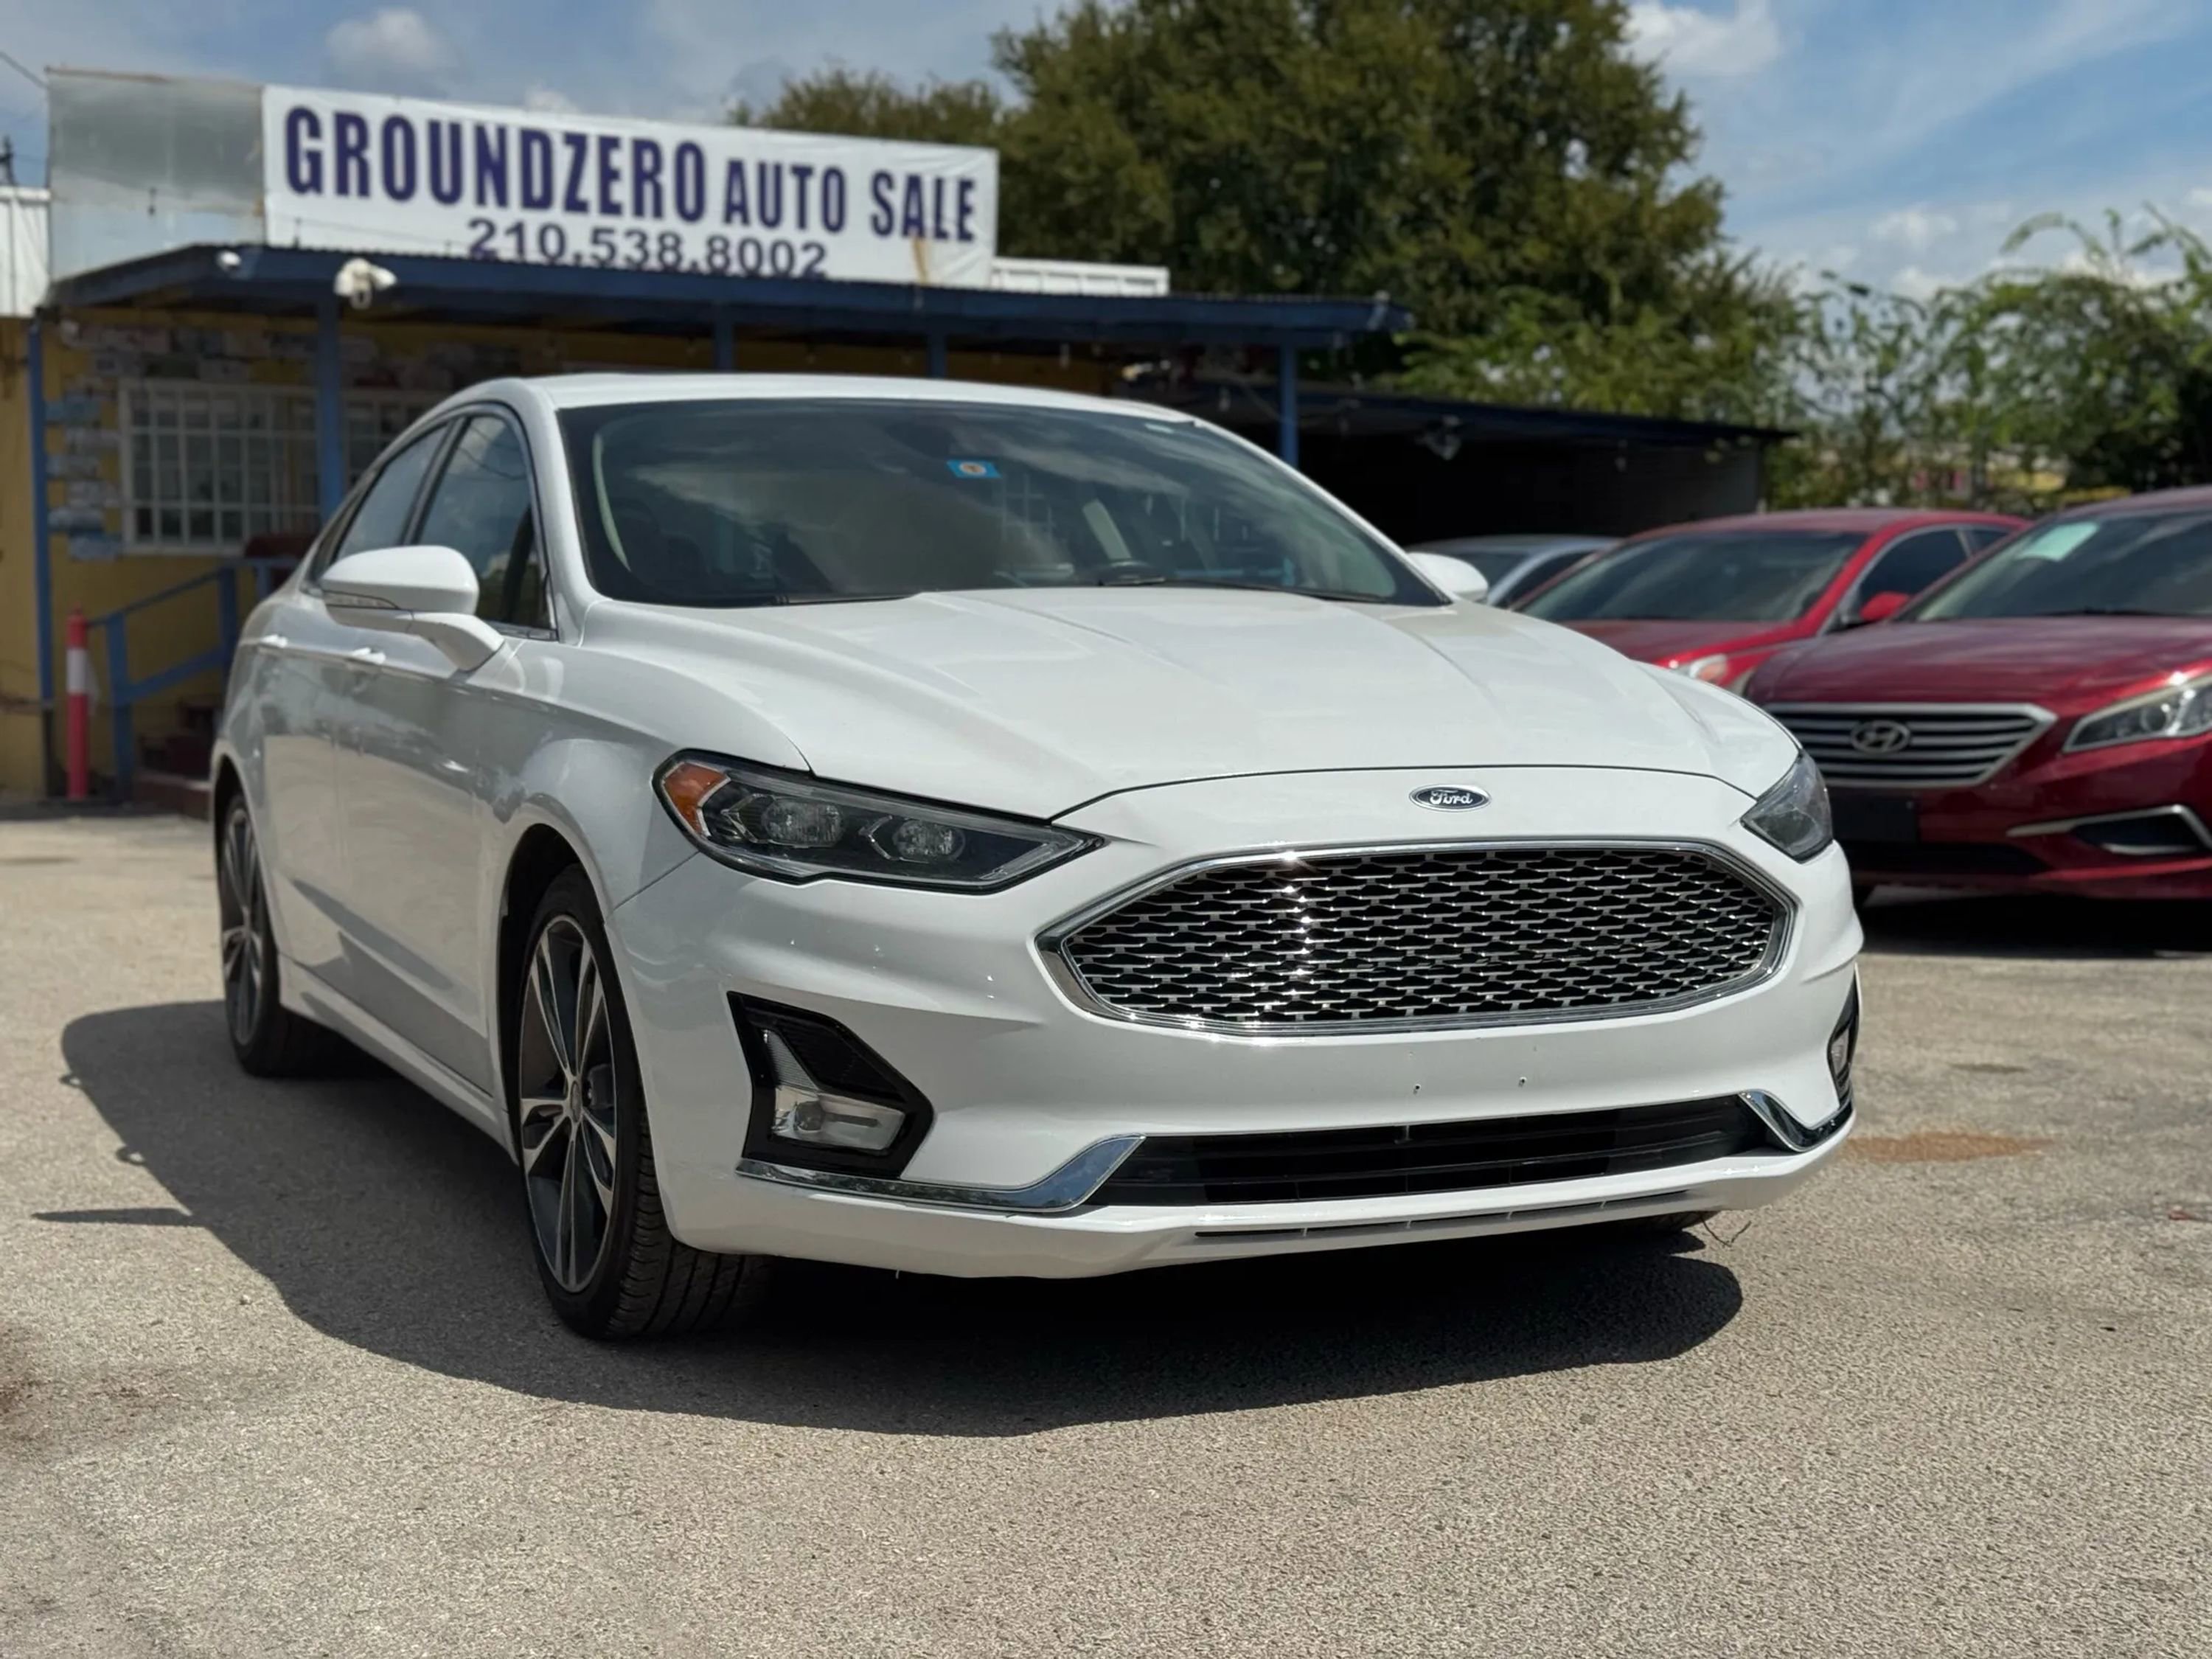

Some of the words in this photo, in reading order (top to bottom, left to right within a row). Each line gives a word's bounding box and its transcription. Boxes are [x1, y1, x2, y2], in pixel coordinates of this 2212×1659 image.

[286, 105, 706, 222] GROUNDZERO
[724, 159, 846, 233] AUTO
[870, 170, 975, 241] SALE
[469, 218, 827, 279] 210.538.8002
[1430, 790, 1473, 804] Ford
